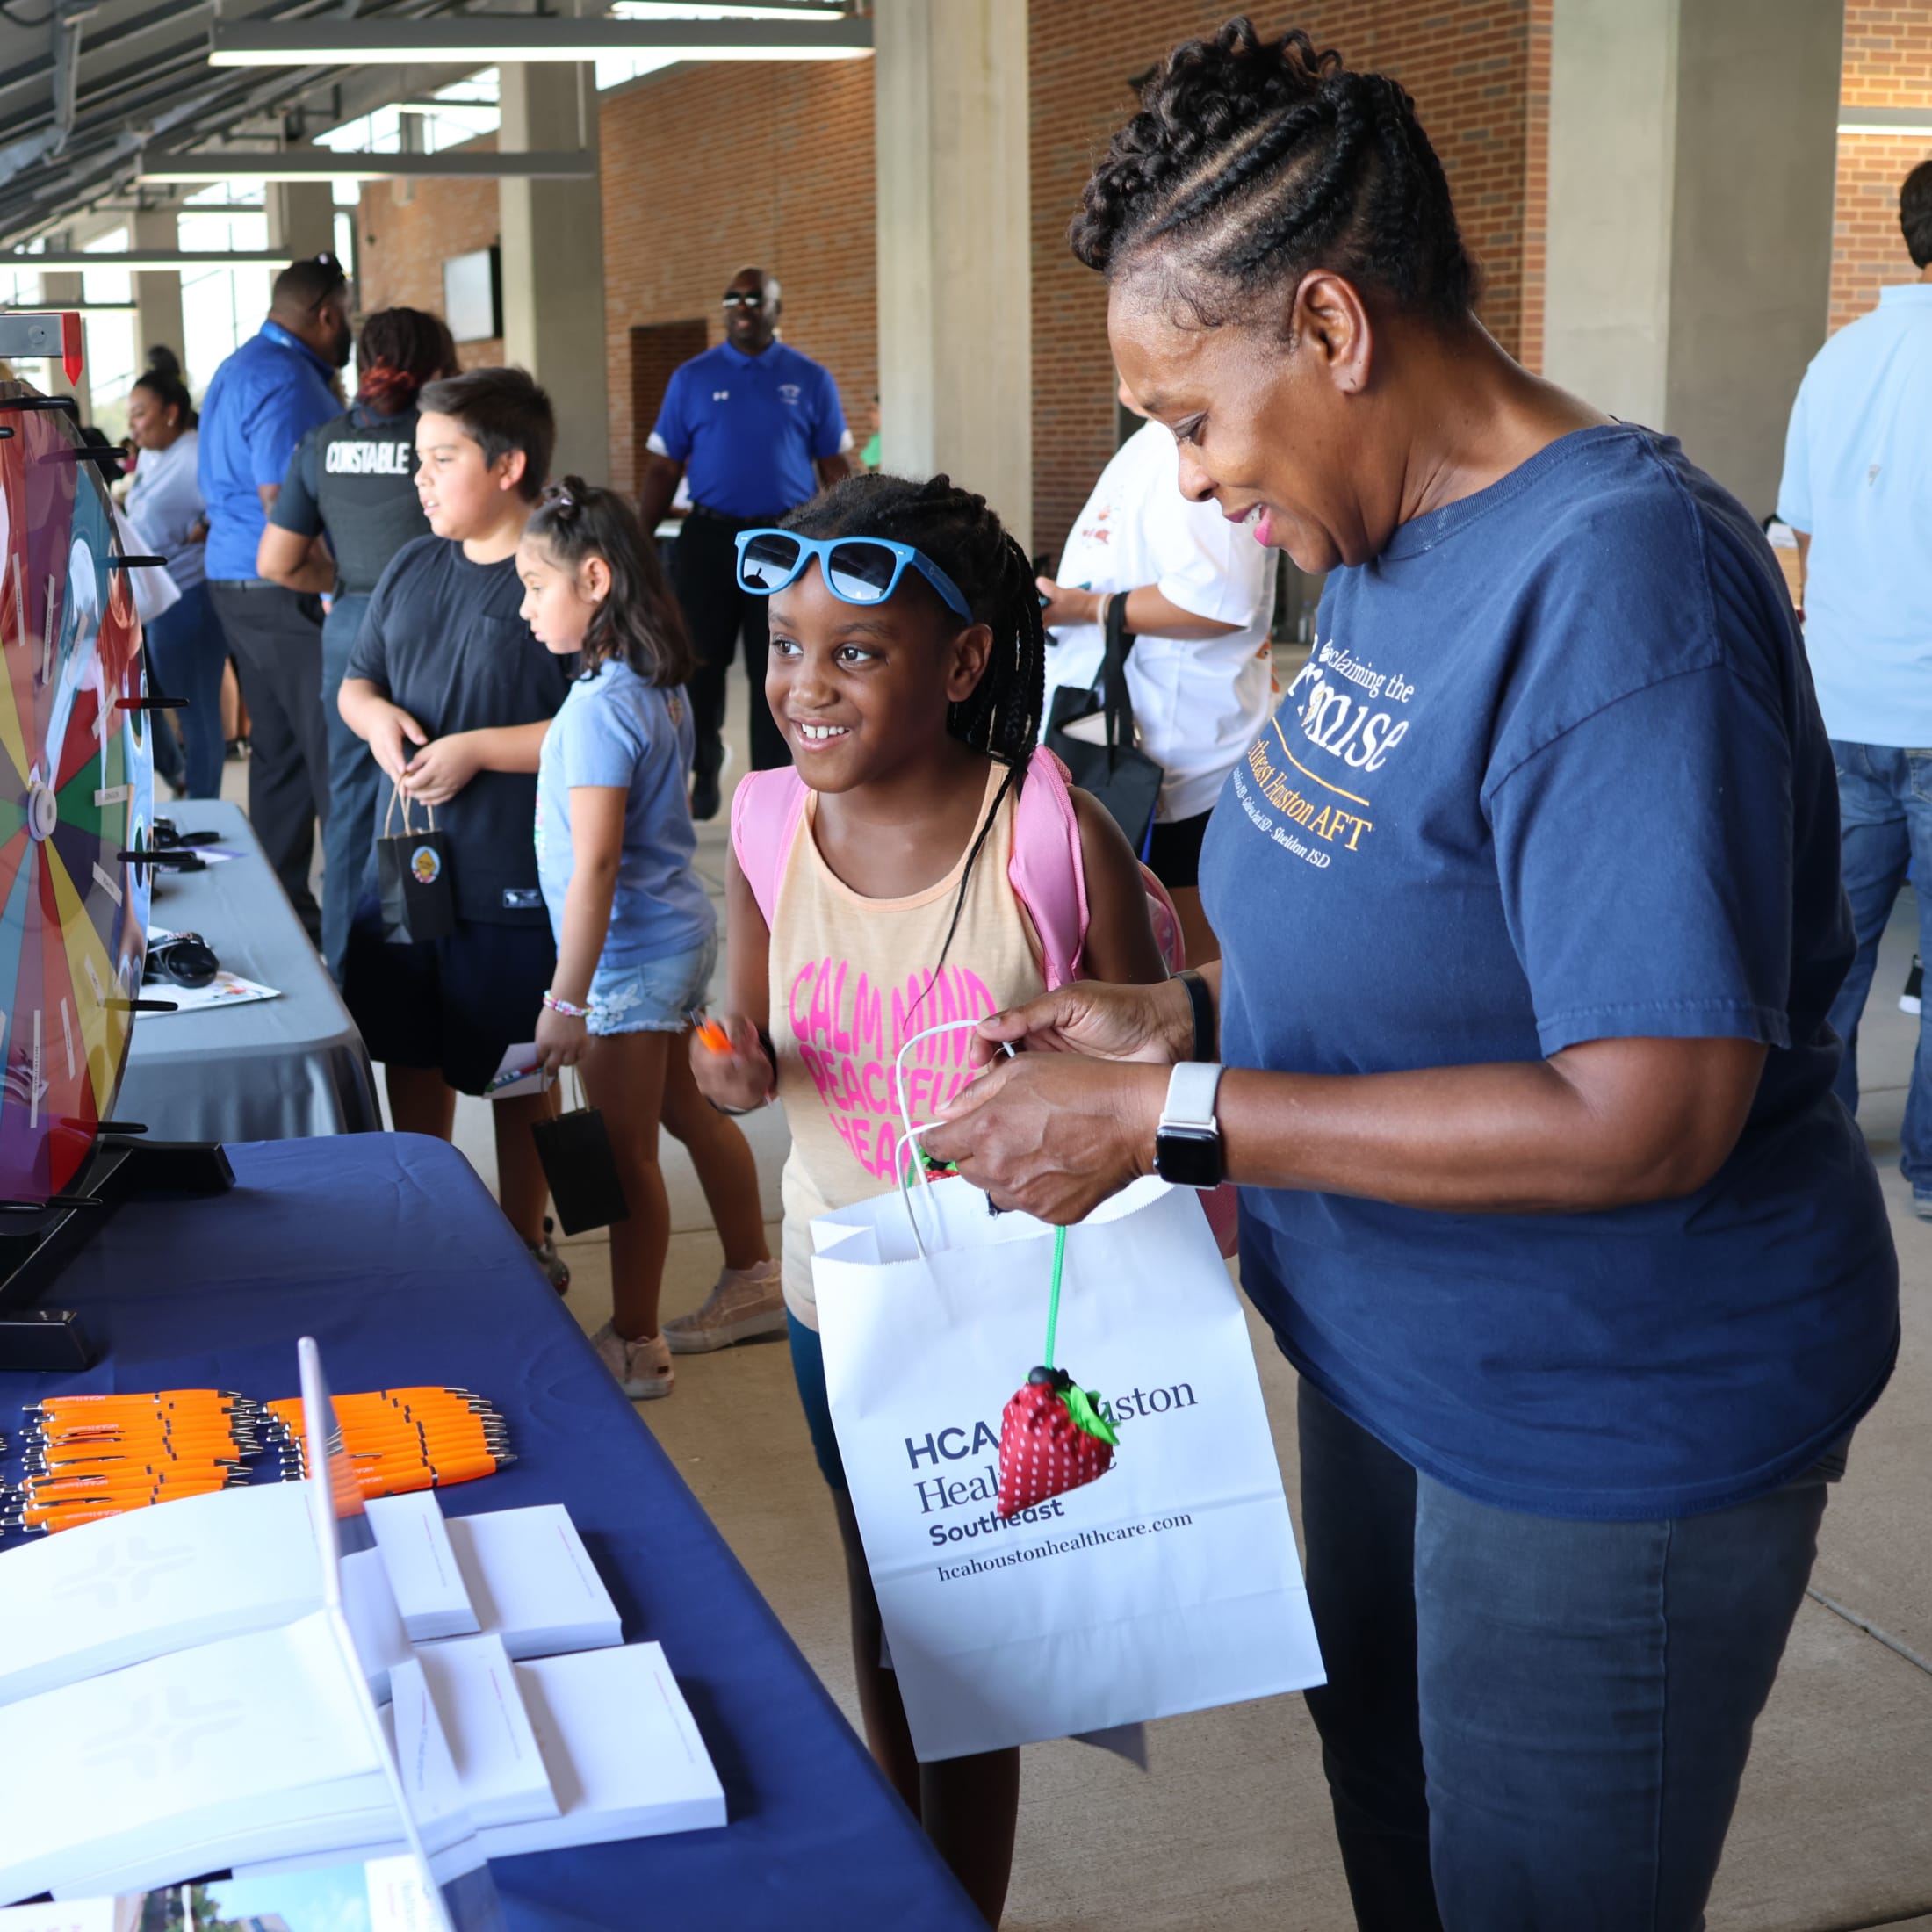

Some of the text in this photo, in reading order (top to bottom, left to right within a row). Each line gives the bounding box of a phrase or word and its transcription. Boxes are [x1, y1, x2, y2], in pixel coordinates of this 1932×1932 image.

[325, 441, 411, 474] CONSTABLE
[1385, 673, 1415, 703] the
[1271, 826, 1308, 858] Sheldon
[1305, 848, 1330, 869] ISD
[1307, 804, 1373, 852] AFT
[789, 955, 998, 1070] CALM MIND
[905, 1421, 1000, 1470] HCA
[928, 1498, 1065, 1546] Southeast
[937, 1512, 1193, 1582] hcahoustonhealthcare.com
